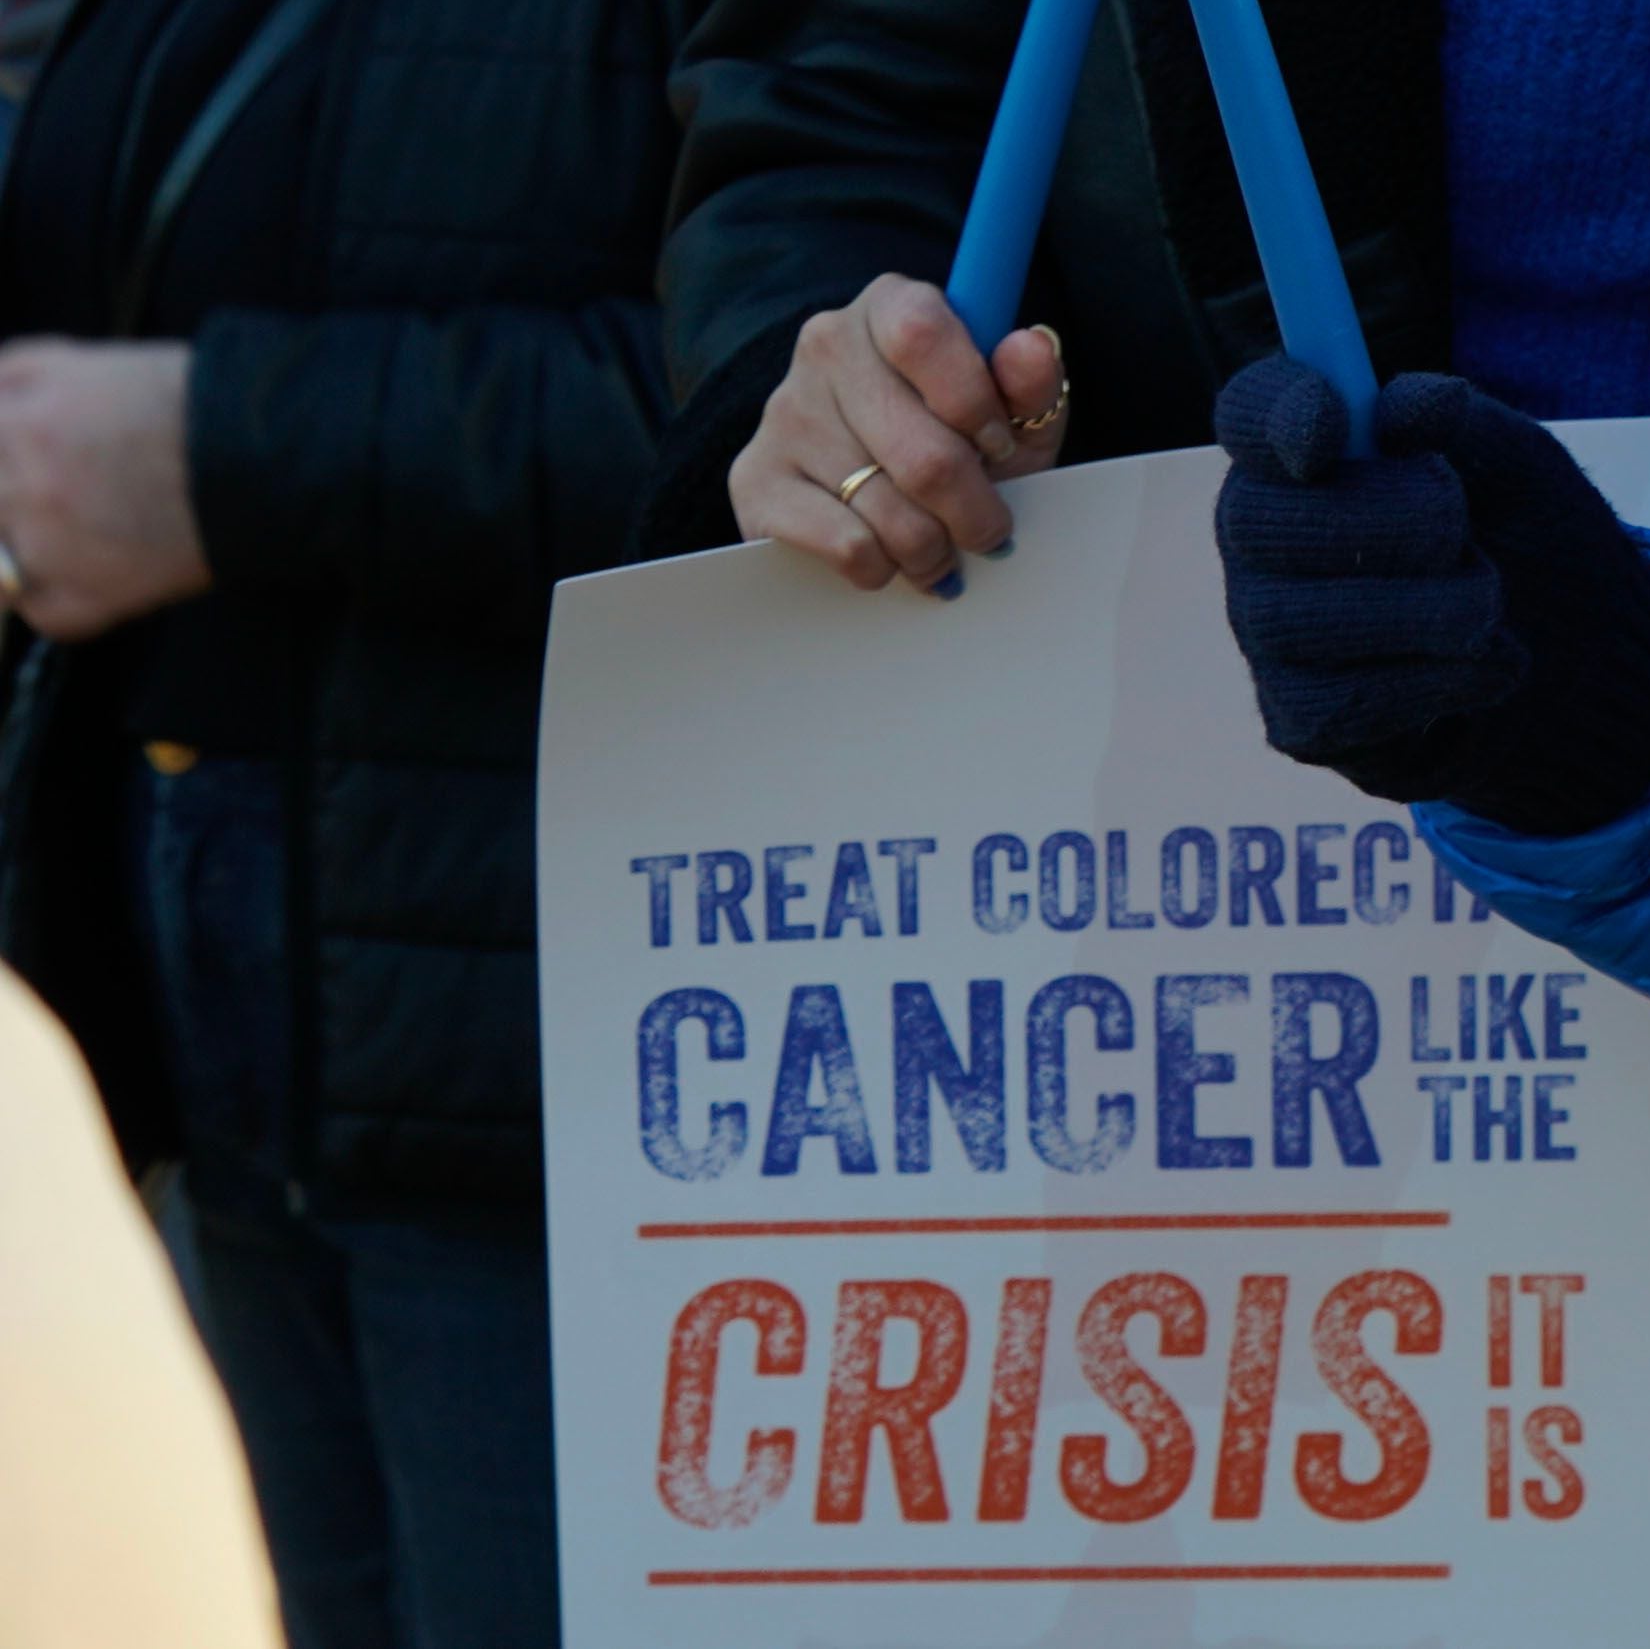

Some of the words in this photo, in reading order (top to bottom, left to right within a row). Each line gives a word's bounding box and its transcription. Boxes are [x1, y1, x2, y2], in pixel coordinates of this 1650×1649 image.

[629, 836, 938, 949] TREAT
[635, 970, 1383, 1182] CANCER
[1410, 971, 1589, 1064] LIKE
[1416, 1072, 1578, 1164] THE
[1486, 1273, 1587, 1390] IT
[655, 1267, 1446, 1532] CRISIS
[1486, 1403, 1586, 1523] IS
